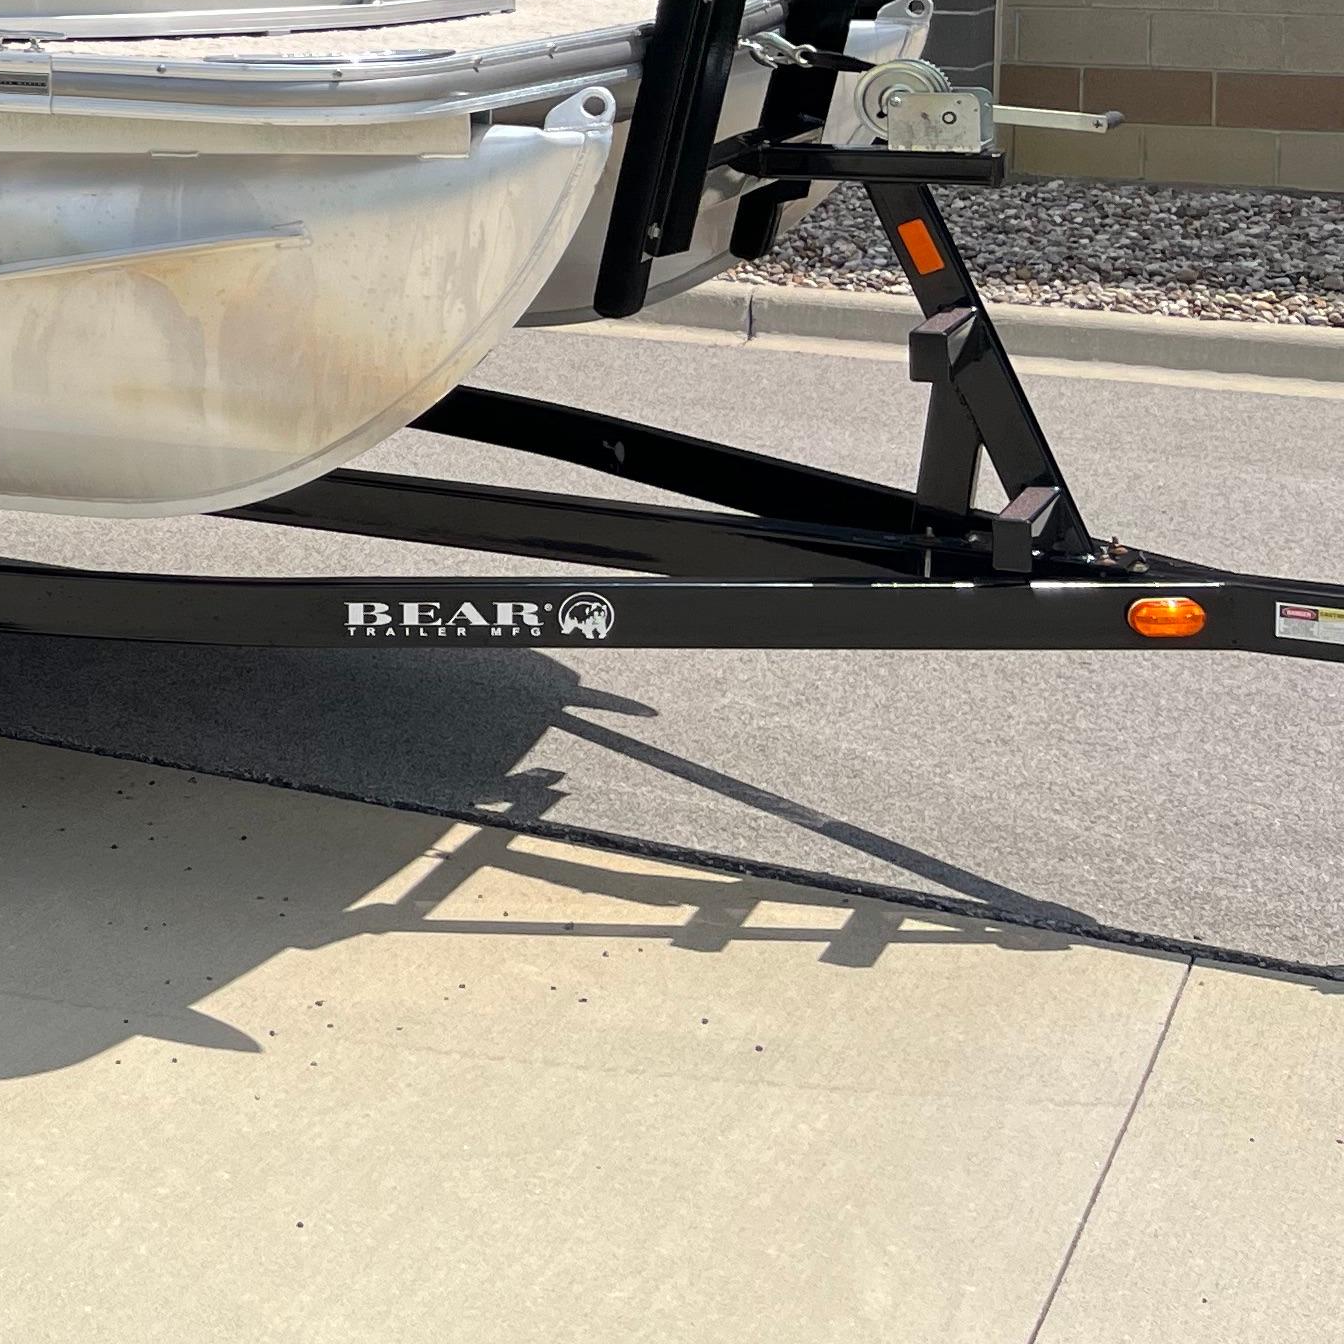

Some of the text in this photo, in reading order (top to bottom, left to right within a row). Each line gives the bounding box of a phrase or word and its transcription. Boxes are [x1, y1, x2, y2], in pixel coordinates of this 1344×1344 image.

[343, 601, 545, 626] BEAR
[348, 627, 542, 637] TRAILER MFG
